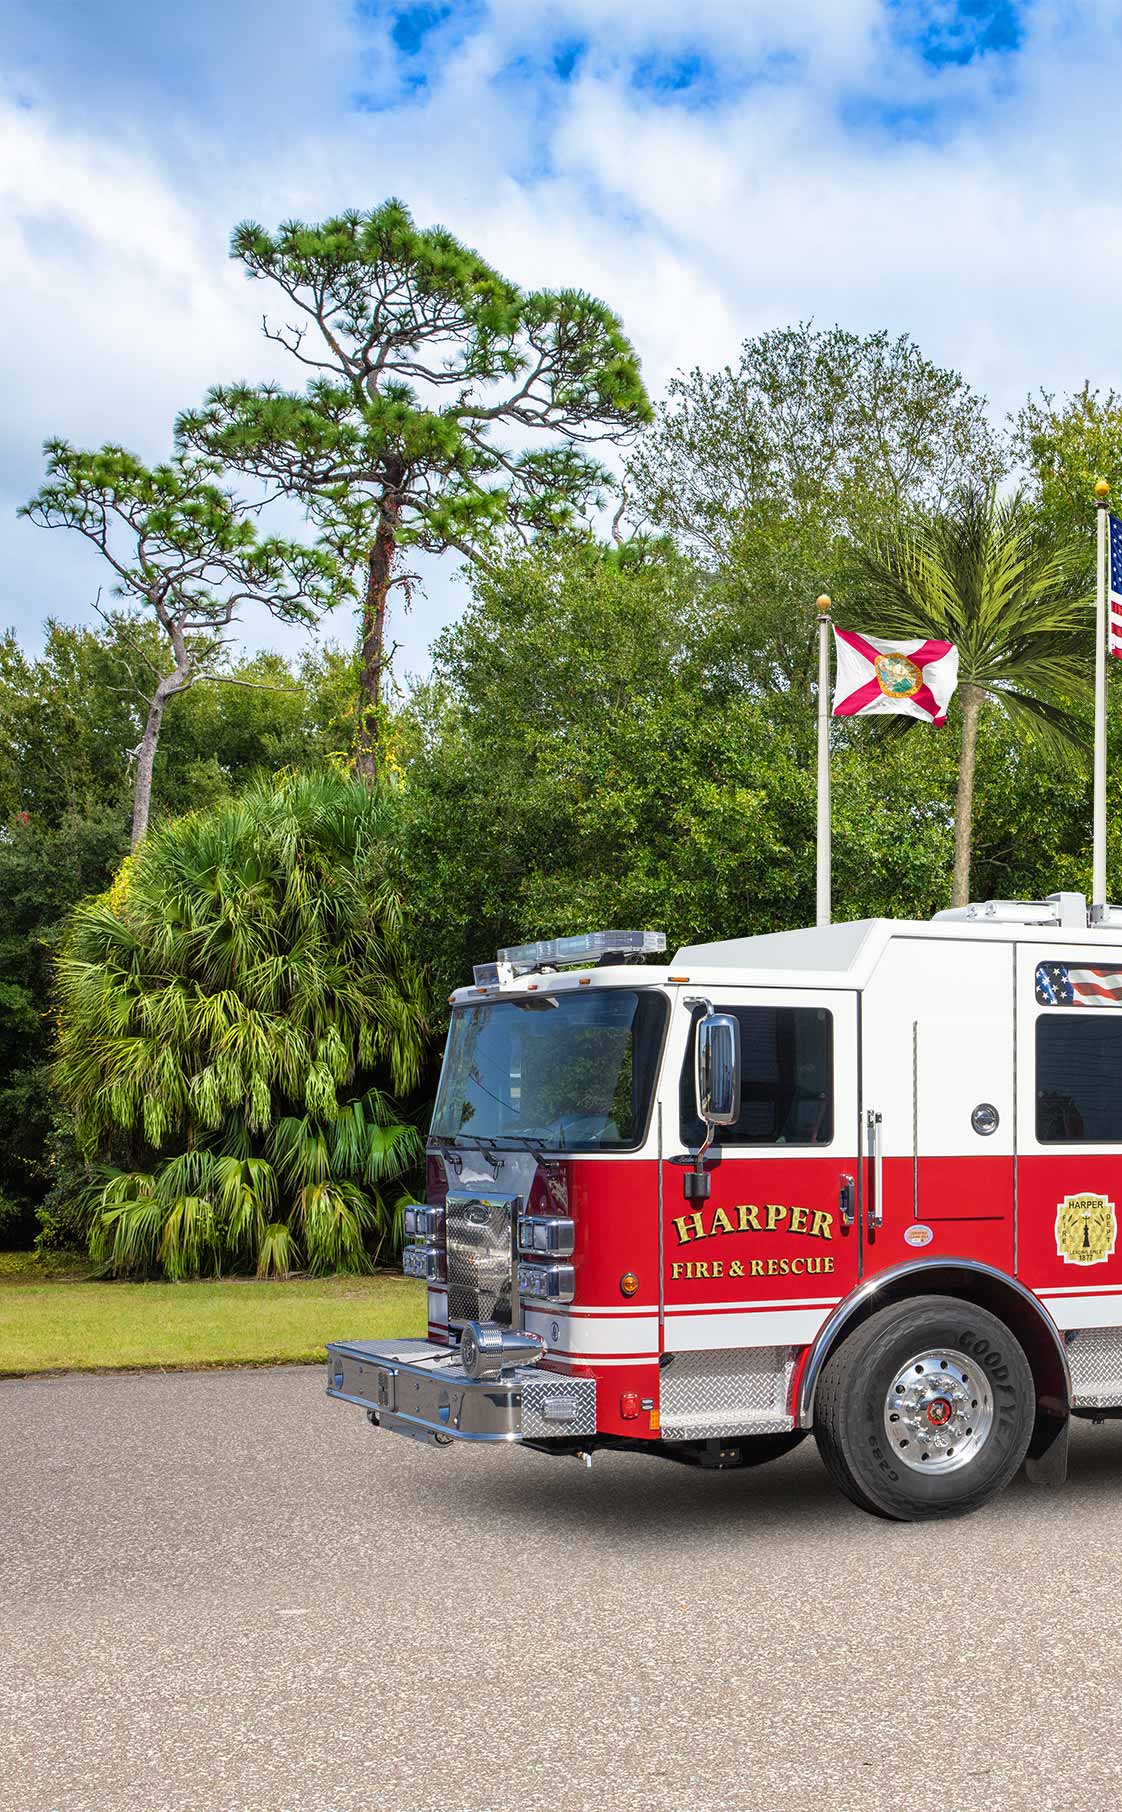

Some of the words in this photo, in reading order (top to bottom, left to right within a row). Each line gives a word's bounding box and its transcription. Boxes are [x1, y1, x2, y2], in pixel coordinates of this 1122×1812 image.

[1068, 1200, 1104, 1209] HARPER
[672, 1204, 834, 1246] HARPER
[671, 1261, 724, 1280] FIRE
[728, 1260, 745, 1278] &
[750, 1257, 835, 1276] RESCUE
